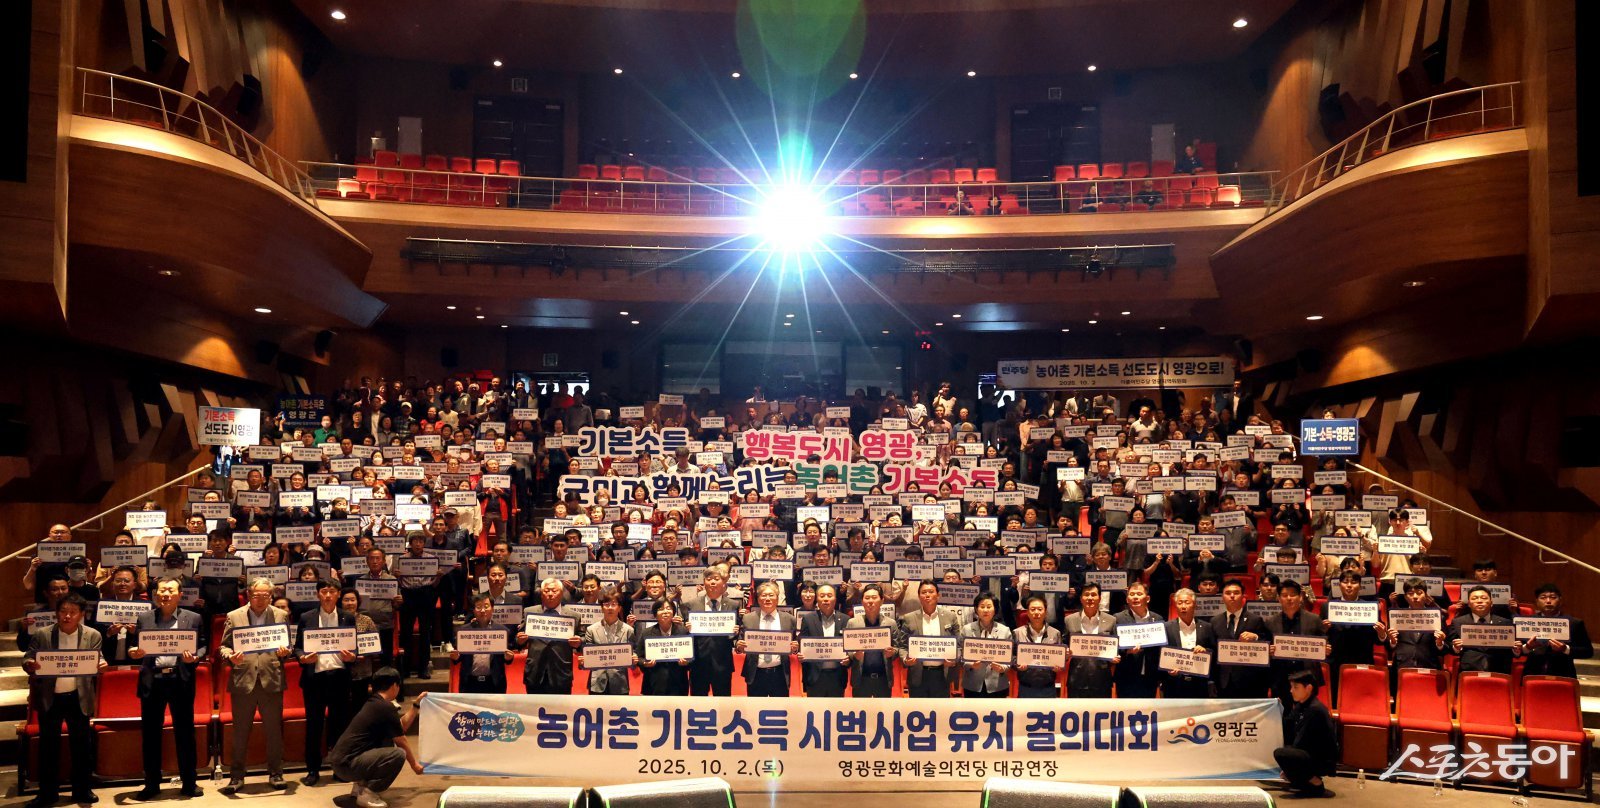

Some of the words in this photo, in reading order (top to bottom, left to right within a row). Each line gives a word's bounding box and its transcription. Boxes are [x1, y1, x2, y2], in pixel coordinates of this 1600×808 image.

[1002, 366, 1028, 375] 민주당
[1036, 365, 1070, 377] 농어촌
[1074, 364, 1119, 377] 기본소득
[1123, 363, 1168, 376] 선도도시
[1173, 362, 1224, 375] 영광으로!
[204, 410, 235, 422] 기본소득
[204, 424, 254, 436] 선도도시영광
[578, 430, 687, 456] 기본소득
[746, 432, 849, 462] 행복도시
[862, 433, 922, 460] 영광,
[455, 714, 475, 726] 함께
[477, 718, 497, 726] 만드는
[498, 716, 520, 727] 영광
[456, 727, 474, 739] 같이
[476, 729, 497, 737] 누리는
[498, 729, 517, 739] 군민
[537, 708, 640, 751] 농어촌
[651, 708, 788, 752] 기본소득
[799, 709, 937, 753] 시범사업
[949, 710, 1014, 752] 유치
[1025, 710, 1158, 752] 결의대회
[1214, 722, 1258, 737] 영광군
[638, 759, 691, 775] 2025.
[701, 760, 727, 775] 10.
[737, 760, 784, 776] 2.(목)
[838, 760, 988, 778] 영광문화예술의전당
[994, 760, 1059, 778] 대공연장
